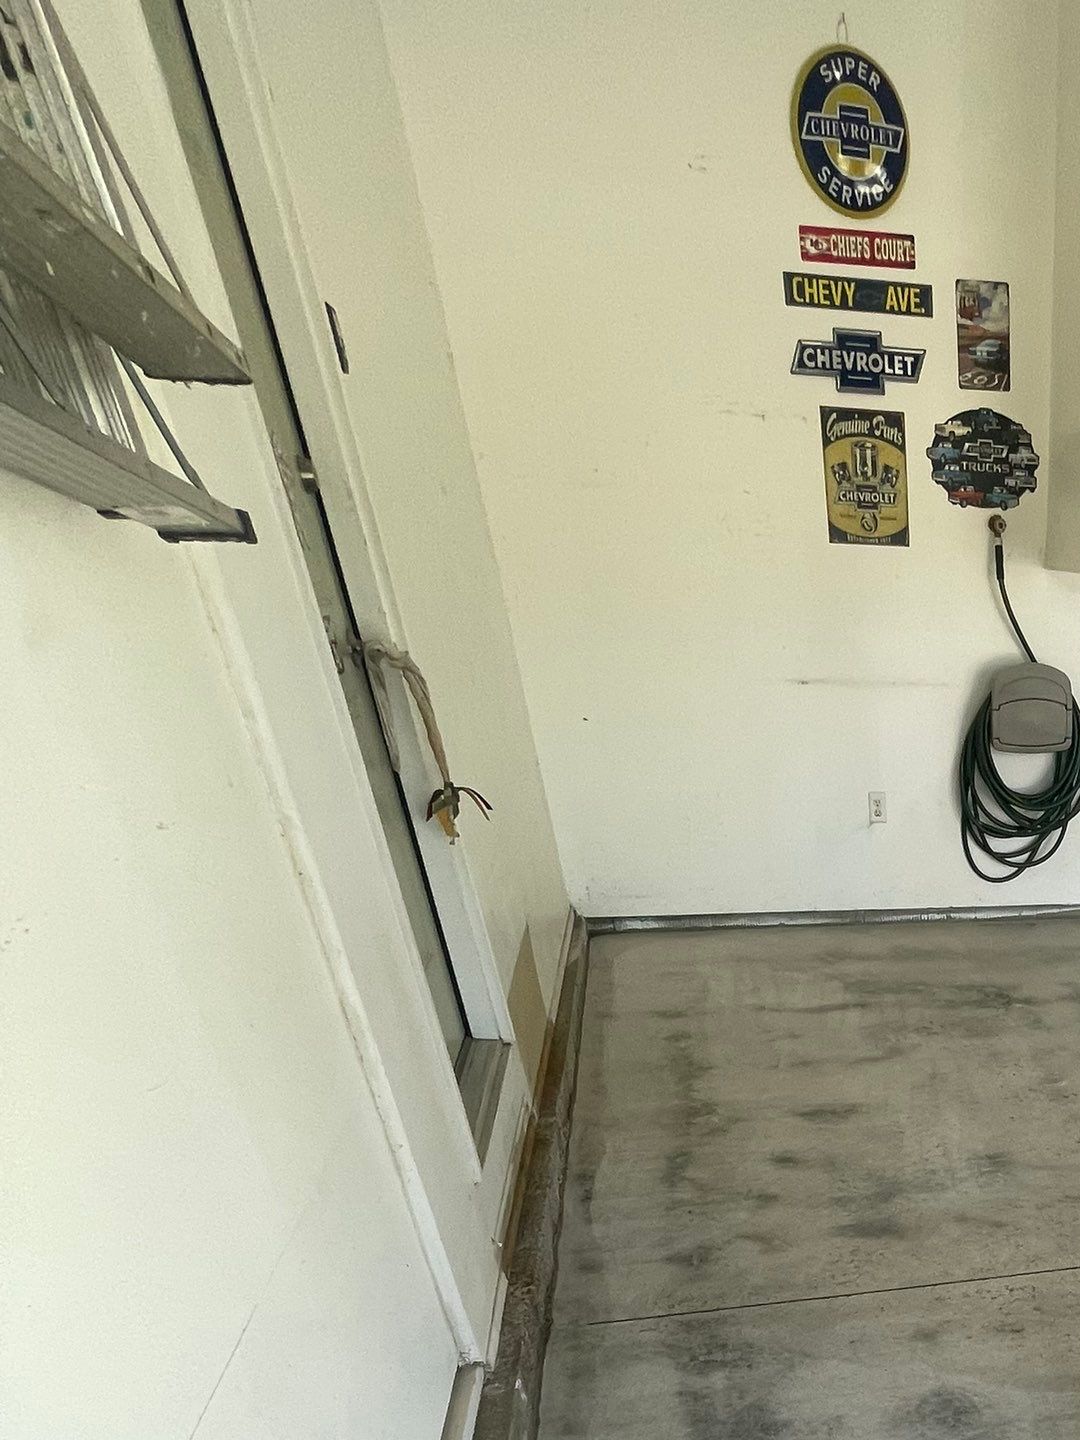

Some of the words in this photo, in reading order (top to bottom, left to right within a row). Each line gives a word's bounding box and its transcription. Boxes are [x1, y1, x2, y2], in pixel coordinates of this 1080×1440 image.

[820, 57, 881, 92] SUPER
[811, 118, 895, 145] CHEVROLET
[818, 166, 893, 206] SERVICE
[830, 234, 871, 259] CHIEFS
[874, 237, 912, 262] COURT
[792, 276, 856, 307] CHEVY
[885, 285, 926, 314] AVE.
[802, 347, 915, 376] CHEVROLET
[826, 412, 871, 442] Genuine
[961, 461, 1011, 474] TRUCKS
[839, 490, 895, 504] CHEVROLET
